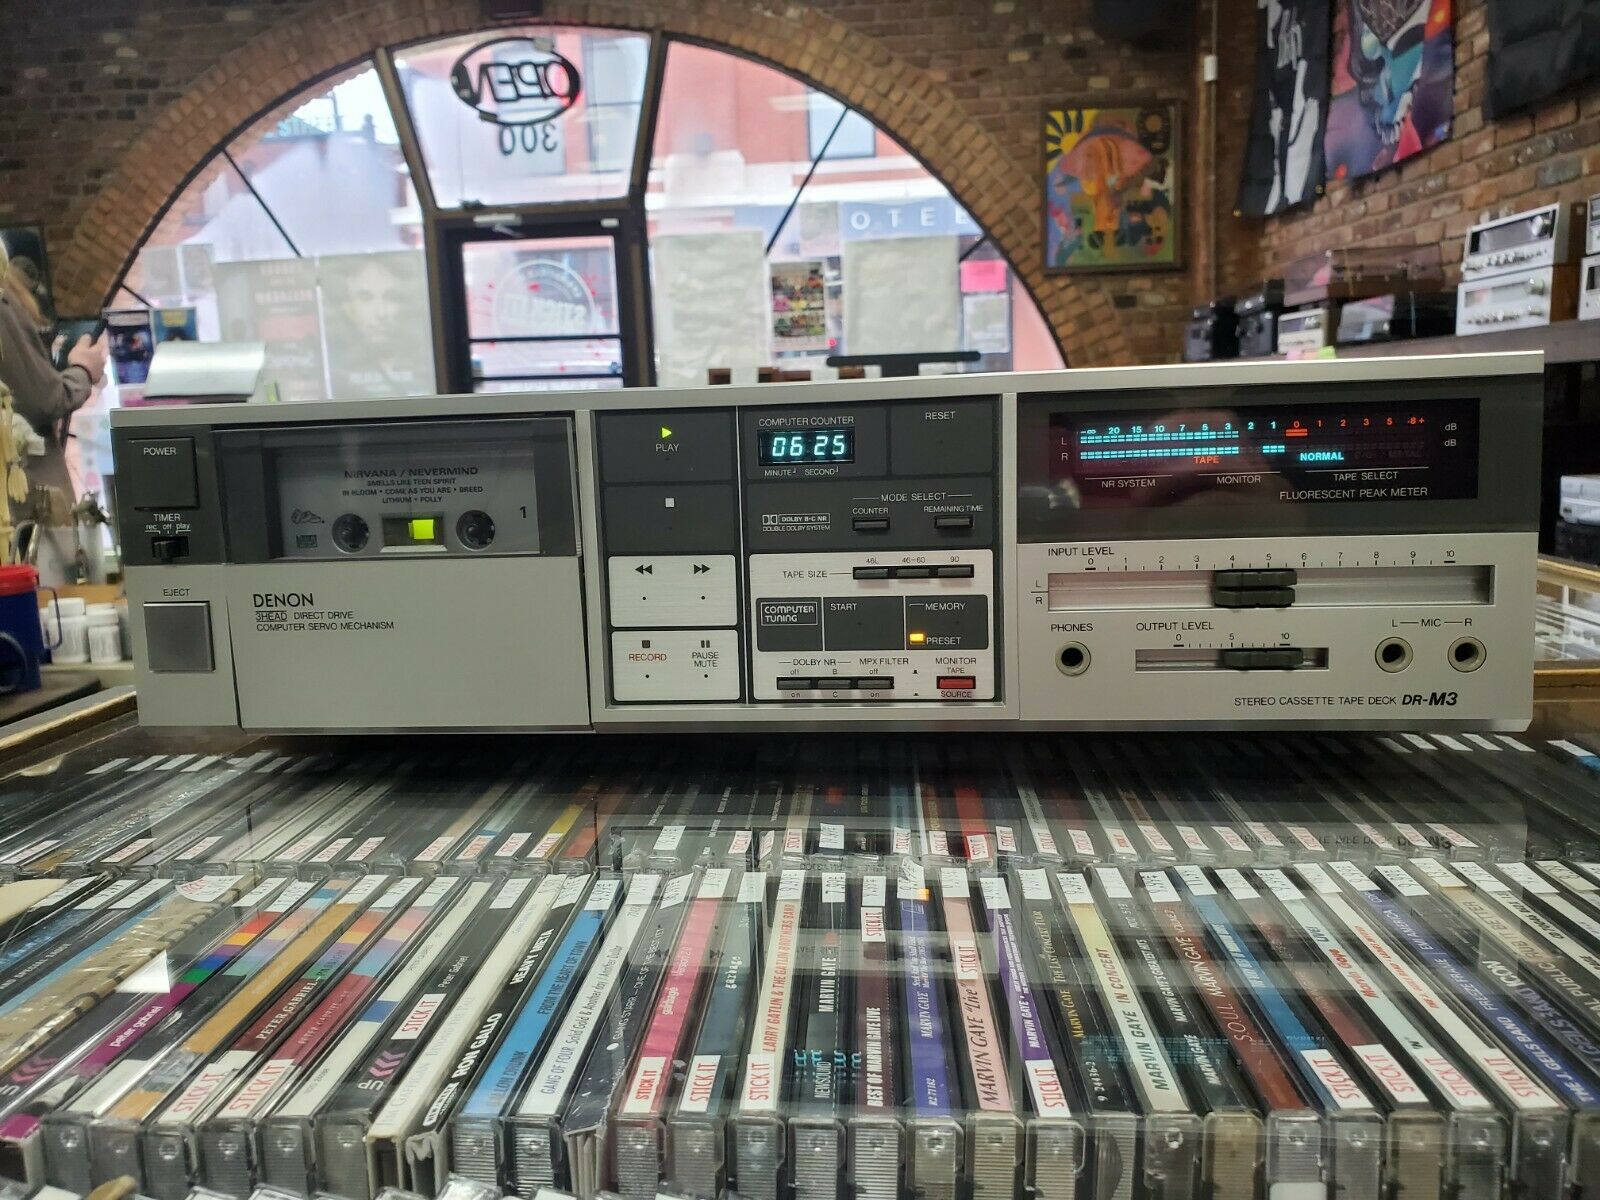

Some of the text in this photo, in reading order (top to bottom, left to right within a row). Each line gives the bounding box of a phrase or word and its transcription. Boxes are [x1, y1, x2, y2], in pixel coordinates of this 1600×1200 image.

[758, 416, 854, 427] COMPUTER COUNTER
[925, 411, 956, 420] RESET
[1445, 423, 1457, 431] dB
[655, 443, 679, 452] PLAY
[772, 435, 845, 457] 06 25
[1444, 439, 1457, 447] dB
[143, 447, 177, 456] POWER
[1300, 452, 1344, 461] NORMAL
[1194, 456, 1220, 464] TAPE
[344, 468, 398, 479] NIRVANA
[407, 467, 479, 477] NEVERMIND
[804, 468, 835, 476] SECOND
[1333, 472, 1398, 481] TAPE SELECT
[367, 477, 456, 487] SMELLS LIKE TEEN SPIRIT
[1101, 479, 1156, 488] NR SYSTEM
[1216, 475, 1261, 484] MONITOR
[351, 488, 377, 496] BLOOM
[384, 487, 407, 495] COME
[881, 492, 947, 502] MODE SELECT
[1280, 487, 1428, 500] FLUORESCENT PEAK METER
[519, 506, 527, 519] 1
[852, 507, 889, 515] COUNTER
[923, 504, 984, 513] REMAINING TIME
[153, 513, 181, 522] TIMER
[1048, 546, 1115, 557] INPUT LEVEL
[782, 570, 828, 579] TAPE SIZE
[163, 588, 191, 597] EJECT
[253, 592, 314, 608] DENON
[764, 606, 815, 614] COMPUTER
[830, 603, 857, 611] START
[925, 602, 966, 611] MEMORY
[255, 610, 354, 622] 3HEAD DIRECT DRIVE
[764, 614, 798, 623] TUNING
[256, 621, 394, 632] COMPUTER SERVO MECHANISM
[1050, 623, 1094, 632] PHONES
[1136, 621, 1214, 632] OUTPUT LEVEL
[1392, 618, 1472, 627] L MIC R
[926, 637, 961, 645] PRESET
[628, 653, 667, 661] RECORD
[793, 658, 836, 667] DOLBY NR
[859, 657, 909, 666] MPX FILTER
[935, 657, 977, 665] MONITOR
[694, 660, 718, 668] MUTE
[946, 666, 965, 674] TAPE
[940, 690, 972, 698] SOURCE
[1234, 692, 1458, 706] STEREO CASSETTE TAPE DECK DR-M3
[778, 920, 793, 951] BROTHERS
[1177, 937, 1202, 961] GAYE
[774, 952, 789, 975] GATLIN
[961, 954, 979, 974] STICK
[437, 956, 471, 989] Peter Gabriel
[725, 956, 742, 989] garbage
[1482, 960, 1526, 987] ICON
[772, 976, 786, 988] THE
[819, 957, 838, 1013] MARVIN GAYE
[1192, 962, 1224, 997] MARVIN
[1539, 962, 1591, 997] PUBLIC
[452, 1047, 475, 1079] RON
[471, 1012, 503, 1050] GALLO
[511, 954, 541, 986] HEAVY
[531, 928, 555, 954] META
[917, 991, 930, 1010] GAYE
[402, 1000, 438, 1032] STICK IT
[767, 998, 783, 1025] GATLIN
[918, 1010, 934, 1038] MARVIN
[1019, 1000, 1041, 1048] MARVIN GAYE
[1096, 949, 1170, 1091] MARVIN GAYE IN CONCERT
[110, 1006, 163, 1048] peter gabriel
[971, 1016, 988, 1048] GAYE
[762, 1025, 779, 1053] LARRY
[866, 1007, 884, 1107] BEST OF MARVIN GAYE LIVE
[1184, 1035, 1222, 1085] MARVIN GAYE
[506, 1051, 529, 1078] DRUNK
[814, 1061, 832, 1099] NEWSOUND
[973, 1051, 1000, 1104] MARVIN
[1313, 1059, 1360, 1100] STICK IT
[1365, 1054, 1417, 1095] STICK IT
[1424, 1057, 1478, 1097] STICK IT
[1484, 1057, 1540, 1097] STICK IT
[229, 1064, 286, 1111] STICK IT
[636, 1070, 657, 1099] STICK IT
[690, 1063, 716, 1103] STICK IT
[751, 1063, 770, 1101] STICK IT
[1035, 1067, 1065, 1109] STICK IT
